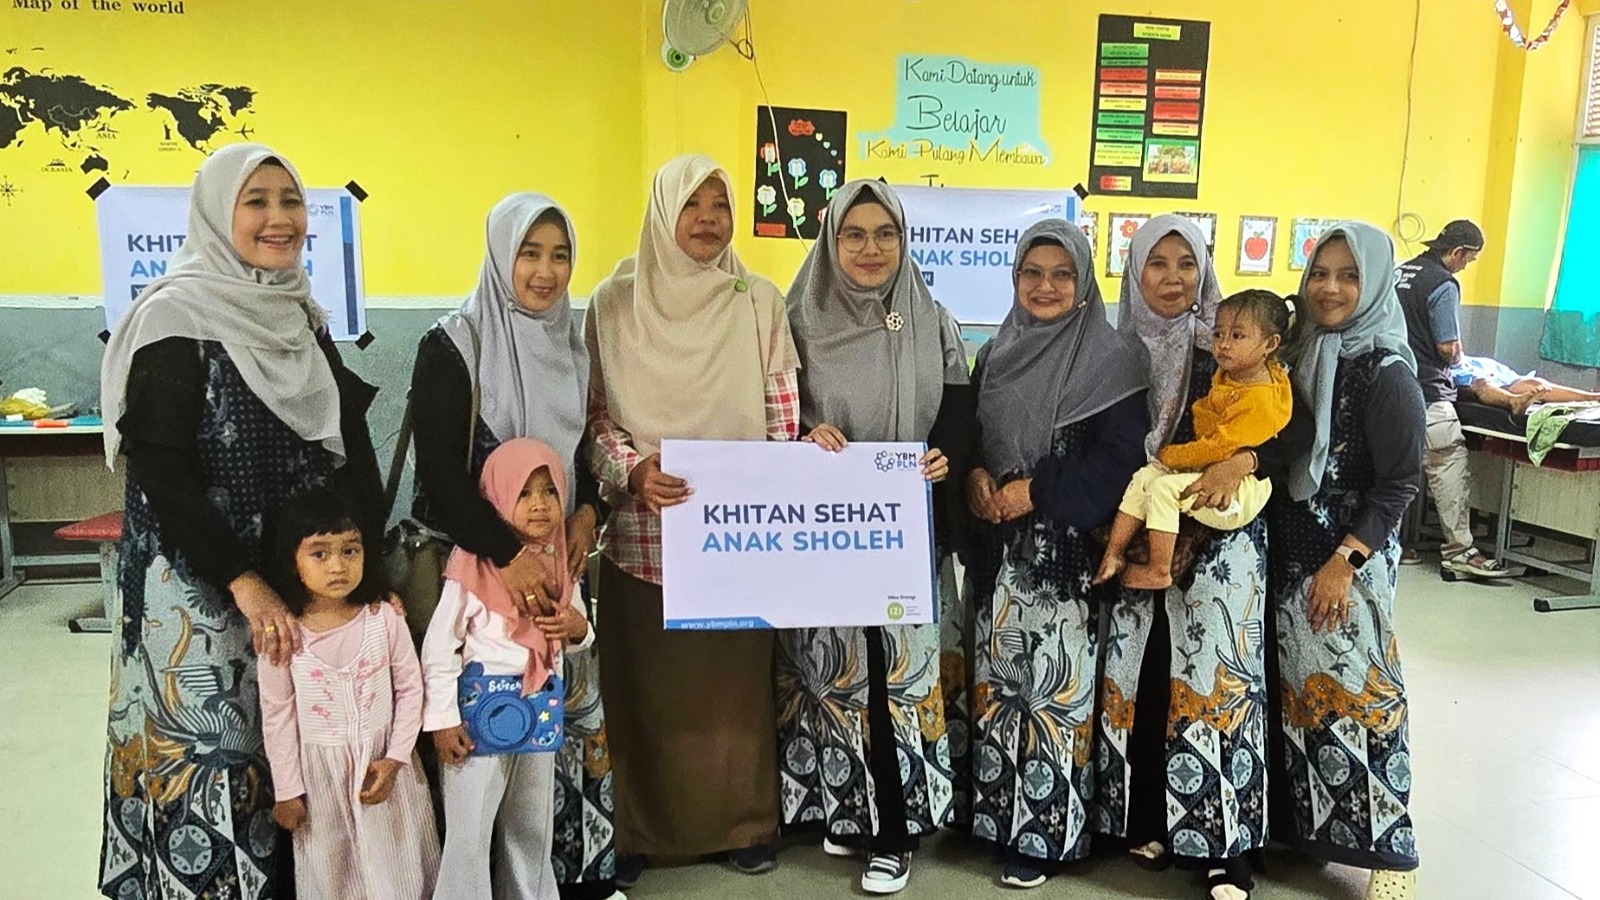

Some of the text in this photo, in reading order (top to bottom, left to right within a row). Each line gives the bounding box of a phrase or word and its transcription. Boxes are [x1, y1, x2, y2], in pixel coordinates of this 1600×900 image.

[12, 0, 184, 15] Map of the world
[905, 58, 945, 82] Kami
[906, 95, 1007, 140] Belajar
[96, 132, 117, 140] ASIA
[867, 140, 906, 160] Kami
[912, 138, 967, 165] Pulang
[127, 233, 186, 253] KHIT
[907, 227, 1018, 245] HITAN SEH
[911, 249, 1014, 267] NAK SHOL
[130, 259, 168, 278] AN
[895, 452, 917, 460] YBM
[896, 460, 917, 468] PLN
[703, 502, 902, 525] KHITAN SEHAT
[701, 529, 905, 553] ANAK SHOLEH
